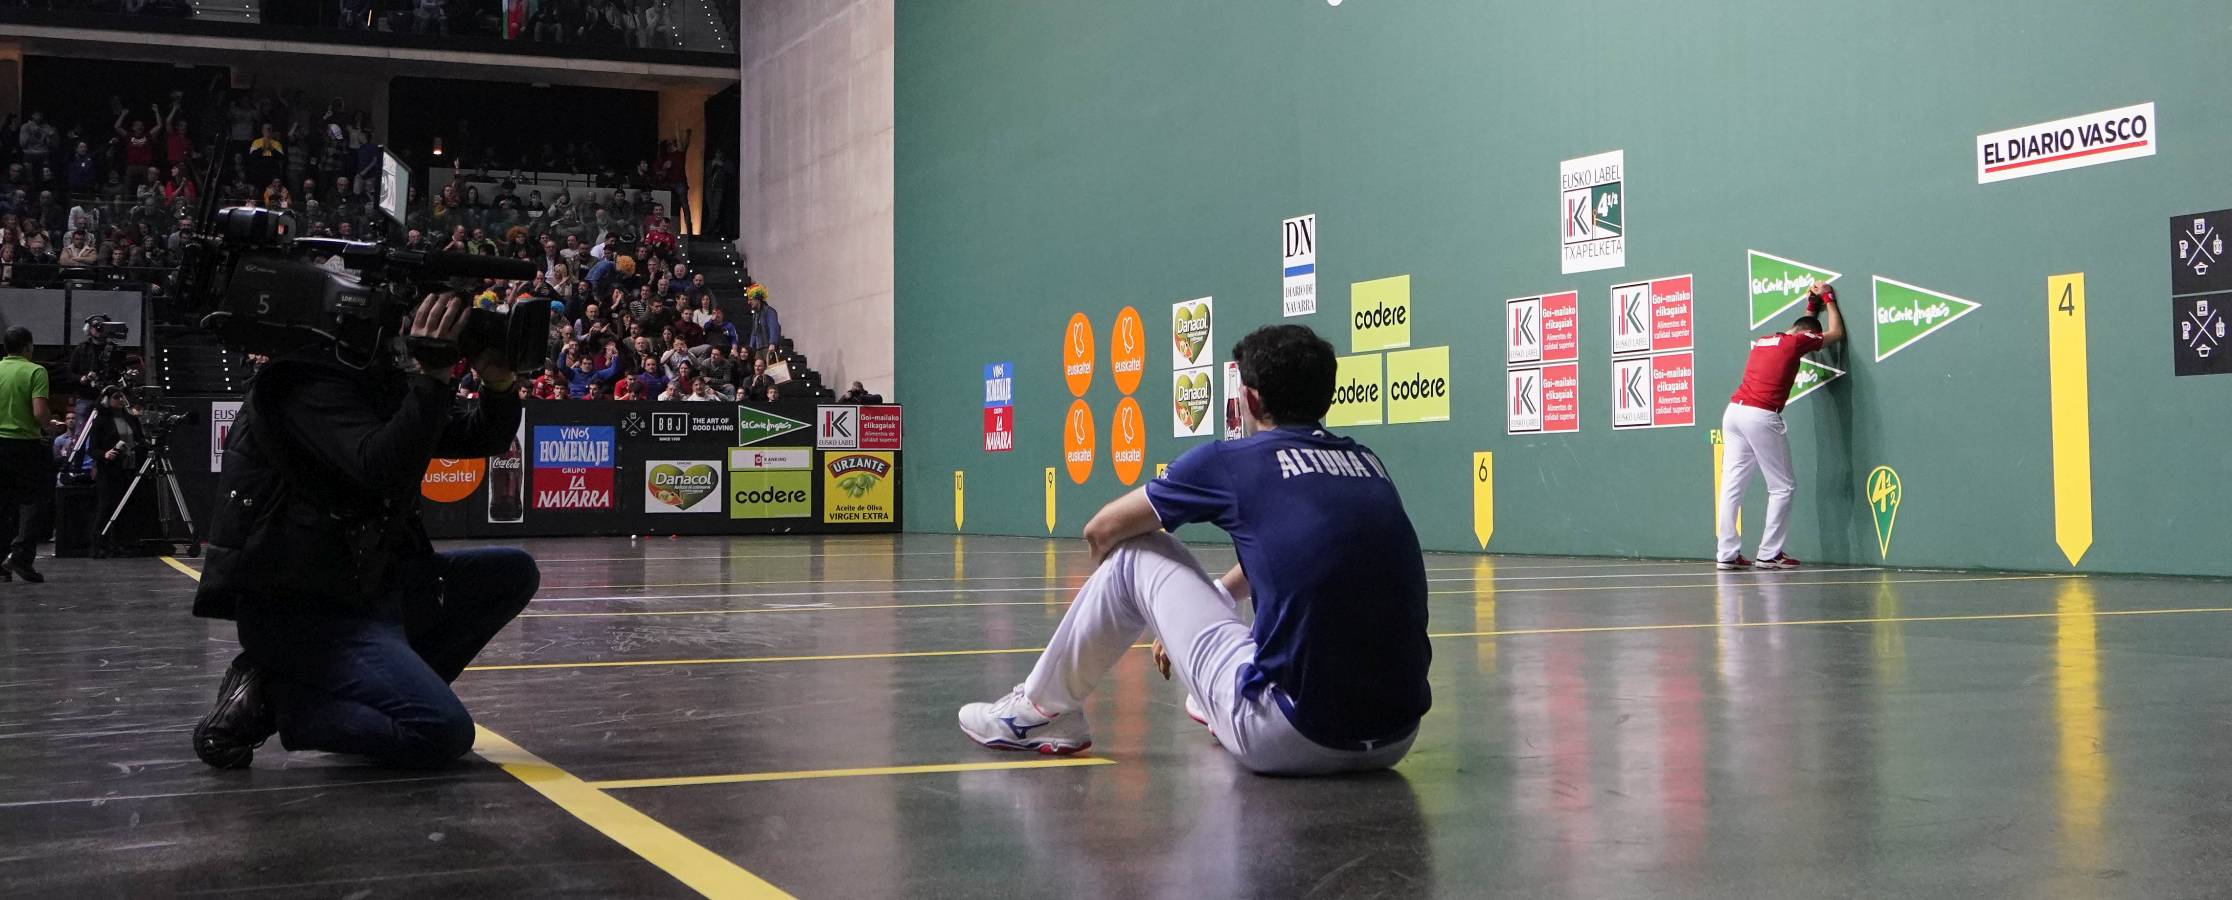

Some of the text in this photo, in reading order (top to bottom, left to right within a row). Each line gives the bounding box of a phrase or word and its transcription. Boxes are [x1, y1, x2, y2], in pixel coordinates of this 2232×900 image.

[1984, 114, 2147, 165] EL DIARIO VASCO
[1562, 164, 1621, 189] EUSKO LABEL
[1285, 218, 1312, 258] DN
[1564, 239, 1623, 261] TXAPELKETA
[1285, 284, 1313, 298] DIARIO DE
[1652, 290, 1690, 304] Goi-mailako
[257, 294, 270, 314] 5
[1285, 299, 1315, 314] NAVARRA
[2058, 282, 2075, 317] 4
[1355, 301, 1406, 330] codere
[1656, 304, 1687, 318] elikagaiak
[1877, 306, 1889, 324] El
[1888, 306, 1914, 323] Corte
[1177, 312, 1208, 334] Danacol
[1067, 362, 1091, 376] euskaltel
[1115, 356, 1141, 373] euskaltel
[1653, 367, 1691, 379] Goi-mailako
[1178, 381, 1208, 402] Danacol
[1391, 372, 1445, 400] codere
[1657, 380, 1688, 393] elikagaiak
[214, 409, 237, 420] EUS
[658, 417, 681, 431] BBJ
[864, 423, 896, 431] elikagaiak
[996, 415, 1003, 431] LA
[985, 429, 1012, 451] NAVARRA
[539, 441, 609, 466] HOMENAJE
[1067, 448, 1091, 462] euskaltel
[1115, 448, 1141, 462] euskaltel
[832, 457, 886, 473] URZANTE
[1276, 448, 1371, 479] ALTUNA
[1479, 457, 1488, 482] 6
[424, 470, 476, 483] uskaltel
[569, 476, 586, 490] LA
[656, 470, 712, 485] Danacol
[956, 475, 963, 490] 10
[1048, 471, 1053, 489] 9
[537, 489, 610, 508] NAVARRA
[735, 485, 806, 504] codere
[866, 504, 883, 512] Oliva
[829, 512, 889, 521] VIRGEN EXTRA
